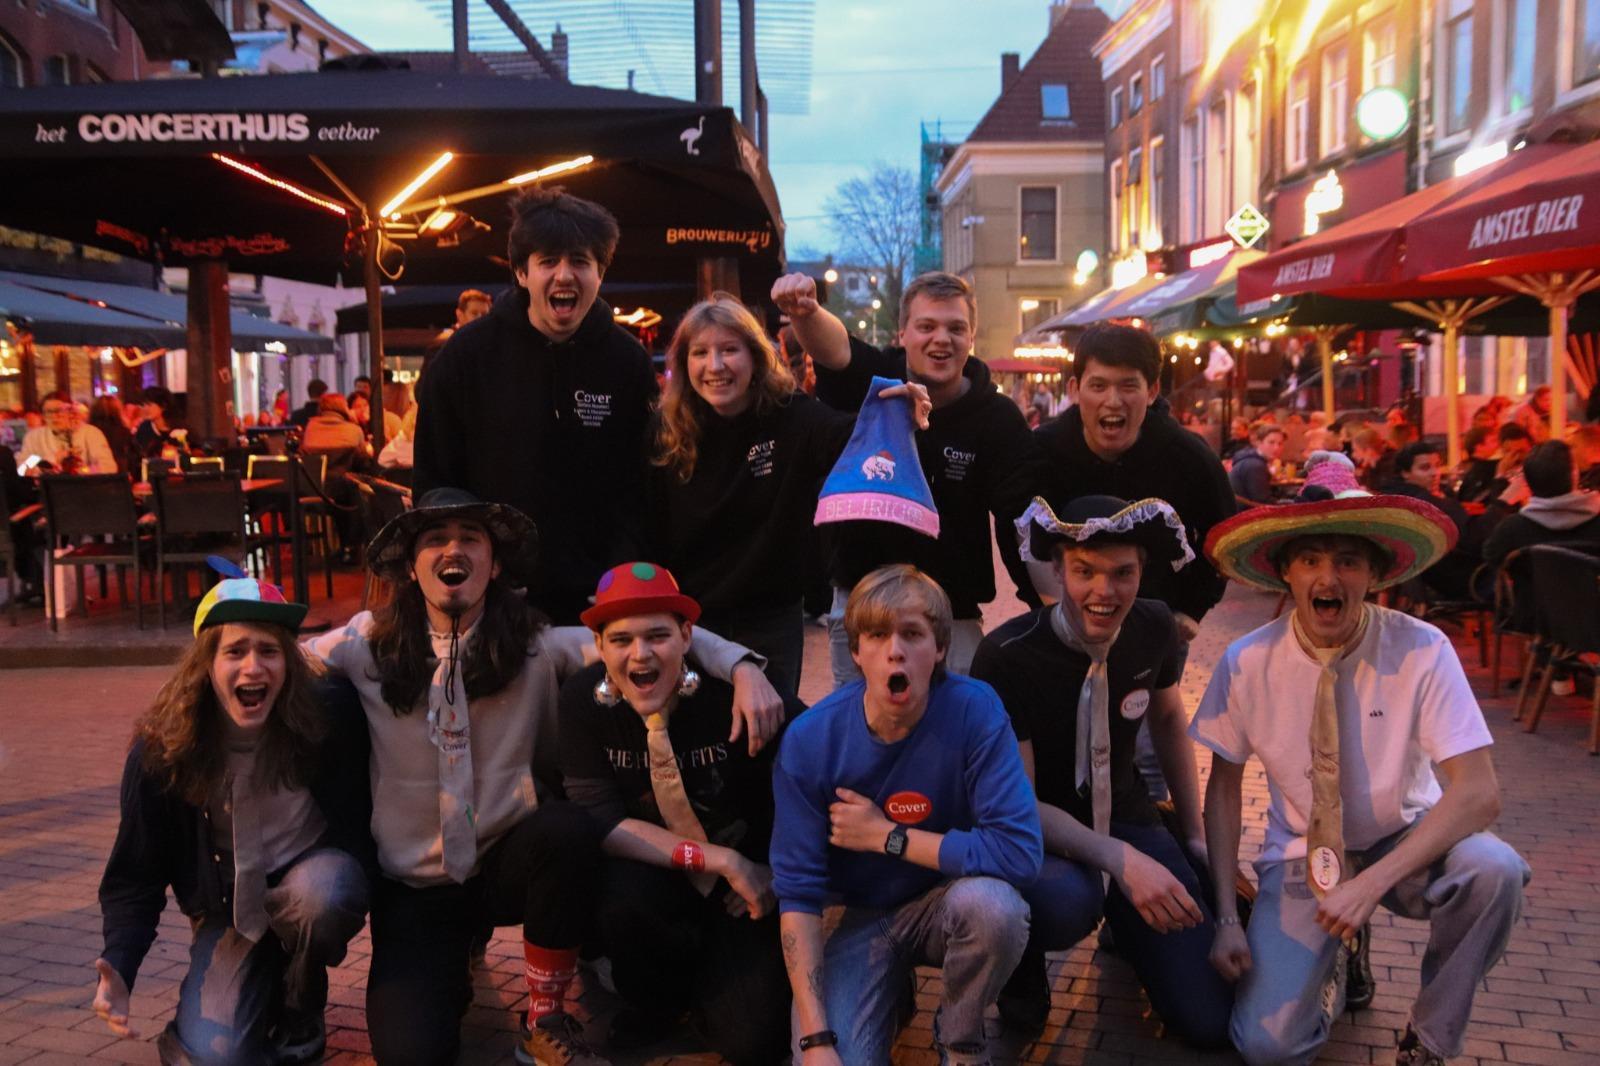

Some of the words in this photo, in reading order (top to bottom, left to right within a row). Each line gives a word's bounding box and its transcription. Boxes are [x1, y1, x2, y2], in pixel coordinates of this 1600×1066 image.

[35, 123, 68, 143] het
[78, 113, 310, 142] CONCERTHUIS
[317, 122, 380, 142] eetbar
[1468, 205, 1534, 250] AMSTEL
[1532, 194, 1584, 234] BIER
[666, 227, 747, 245] BROUWERIJ
[1273, 258, 1310, 286] AMSTEL
[1308, 253, 1336, 280] BIER
[574, 390, 612, 404] Cover
[943, 446, 976, 462] Cover
[441, 742, 467, 752] Cover
[690, 742, 728, 769] FITS
[888, 801, 927, 815] Cover
